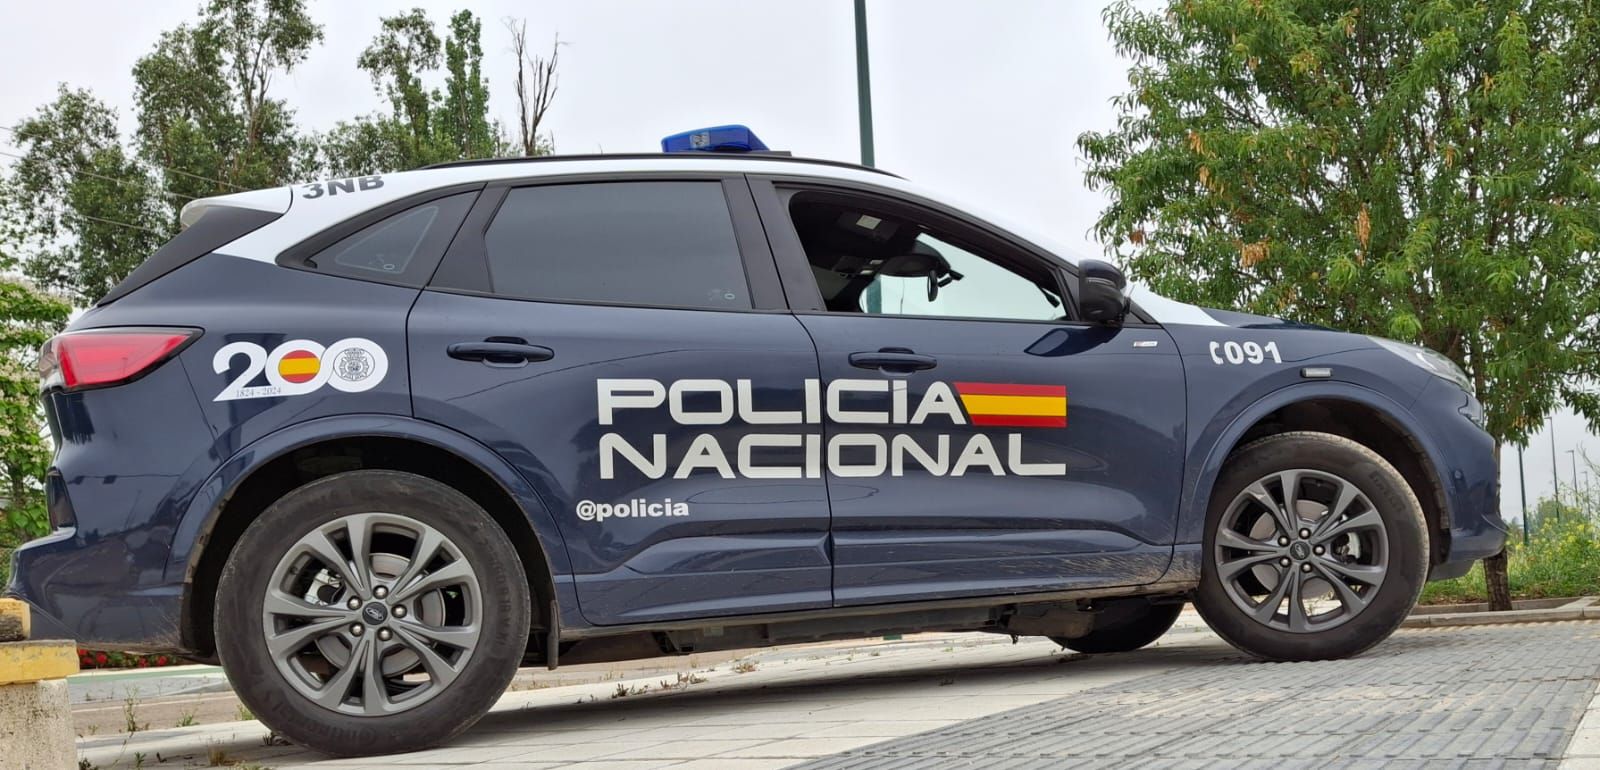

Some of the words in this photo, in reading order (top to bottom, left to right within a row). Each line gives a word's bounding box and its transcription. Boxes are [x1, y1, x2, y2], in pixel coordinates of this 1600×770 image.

[302, 175, 385, 199] 3NB
[212, 337, 389, 402] 200
[236, 388, 255, 398] 1824
[262, 386, 281, 396] 2024
[600, 432, 1067, 480] NACIONAL
[576, 498, 689, 522] @policia
